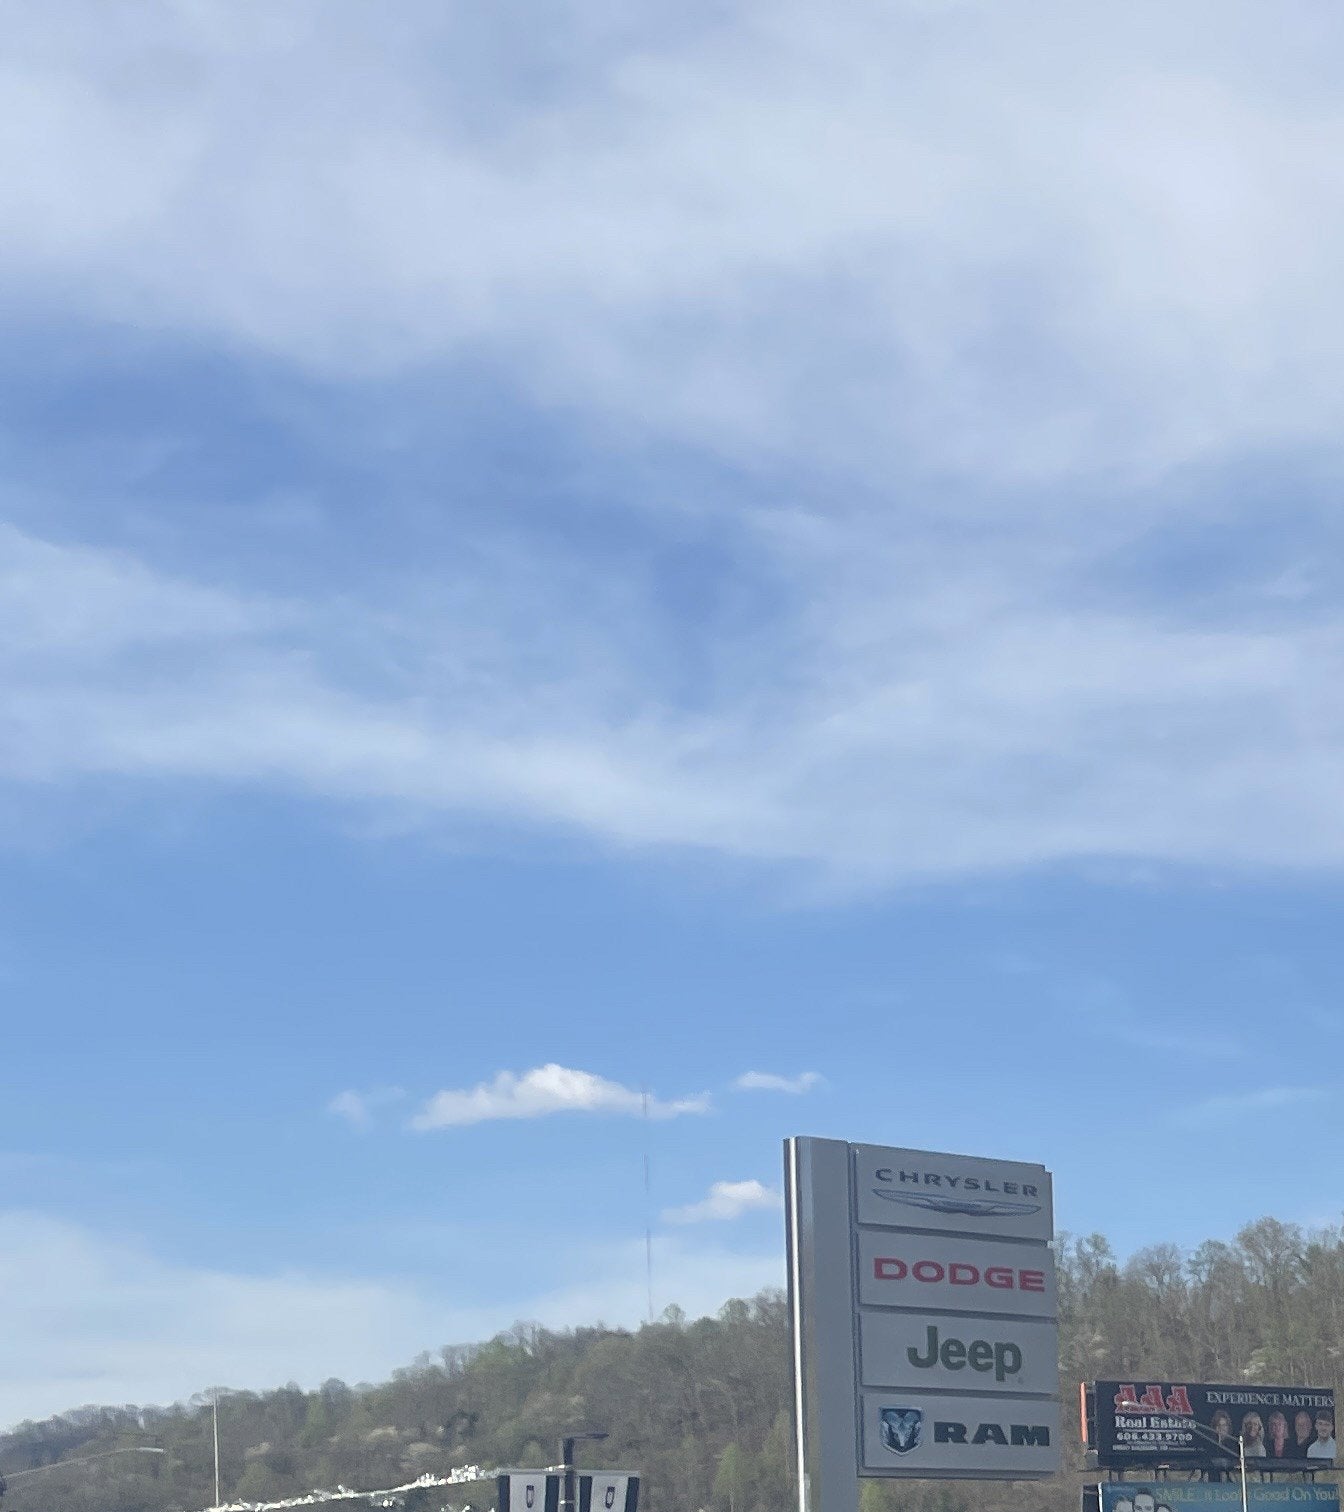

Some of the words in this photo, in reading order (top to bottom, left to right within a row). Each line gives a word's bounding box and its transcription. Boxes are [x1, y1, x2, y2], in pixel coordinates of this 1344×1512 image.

[875, 1168, 1038, 1198] CHRYSLER
[874, 1257, 1045, 1292] DODGE
[907, 1325, 1023, 1382] Jeep
[1206, 1391, 1280, 1406] EXPERIENCE
[1282, 1394, 1334, 1407] MATTERS
[934, 1421, 1050, 1447] RAM
[1115, 1415, 1147, 1428] Real
[1150, 1416, 1197, 1429] Estate
